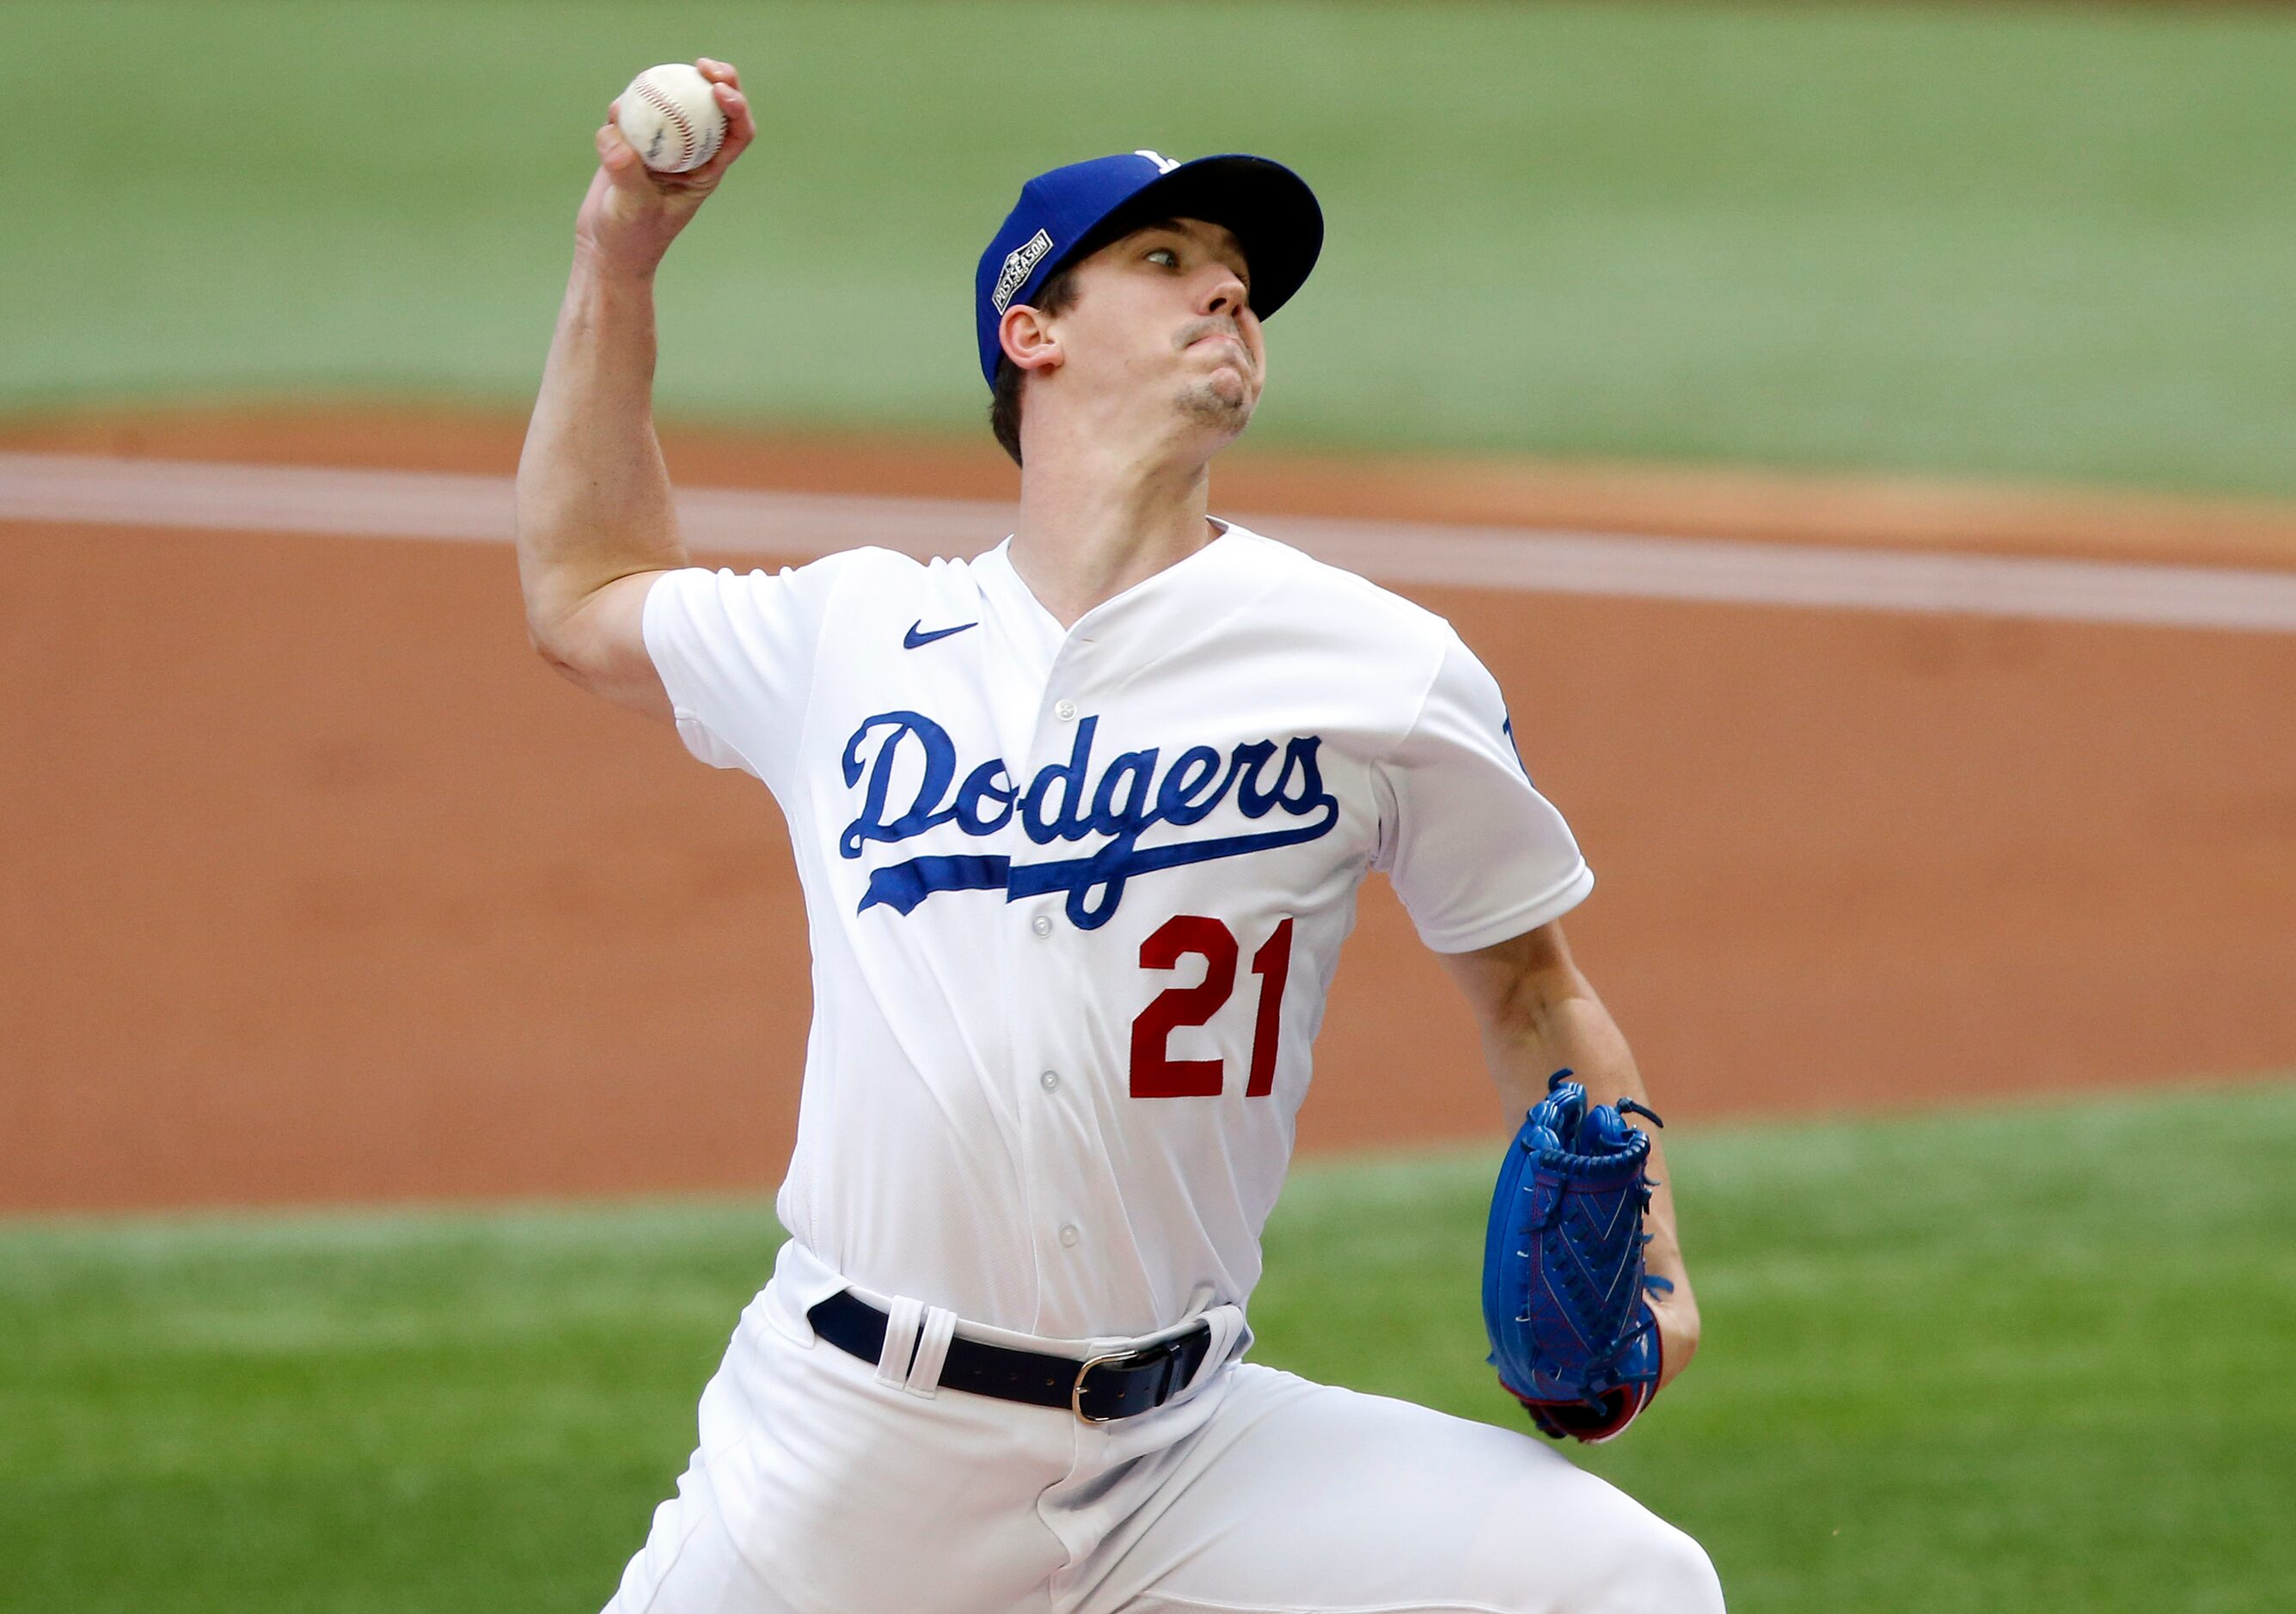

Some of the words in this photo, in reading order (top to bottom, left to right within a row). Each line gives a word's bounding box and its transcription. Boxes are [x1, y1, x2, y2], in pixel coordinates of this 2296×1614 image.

[995, 235, 1048, 307] POSTSEASON
[839, 710, 1339, 931] Dodgers
[1130, 914, 1294, 1098] 21
